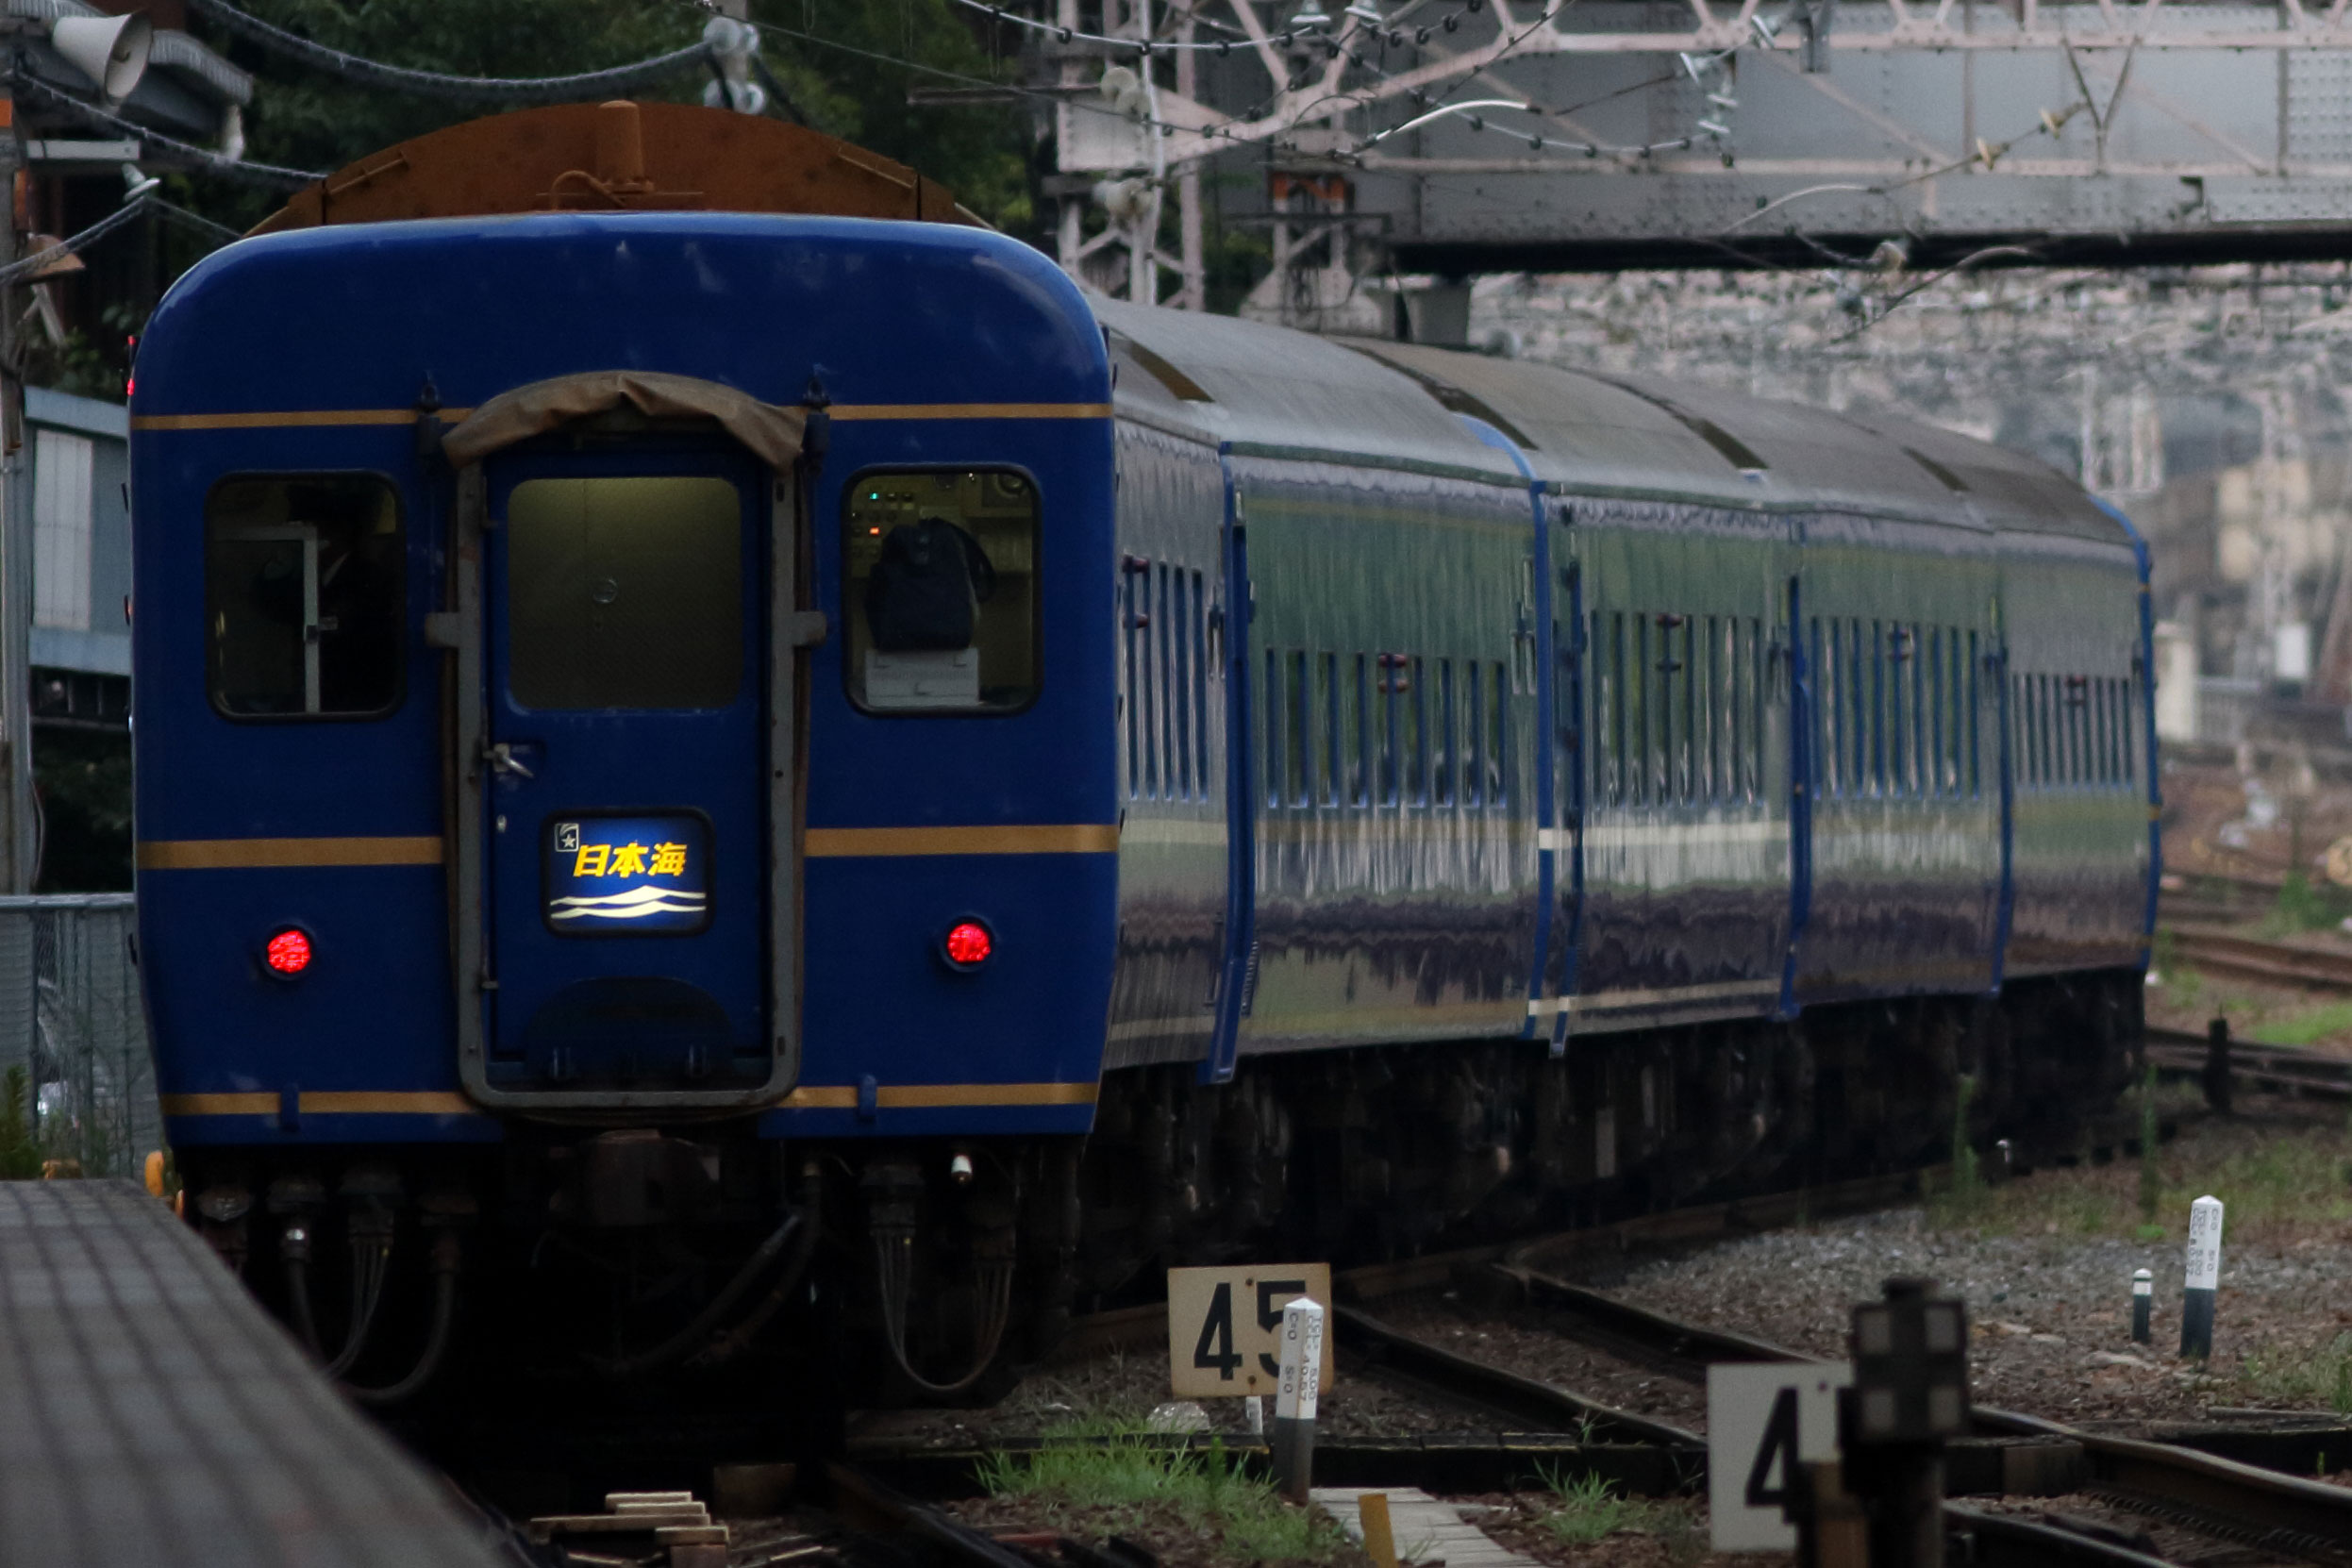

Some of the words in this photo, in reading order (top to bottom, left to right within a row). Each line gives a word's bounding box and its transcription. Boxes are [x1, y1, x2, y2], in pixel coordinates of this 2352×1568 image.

[573, 841, 688, 878] 日本海
[1193, 1279, 1306, 1381] 45
